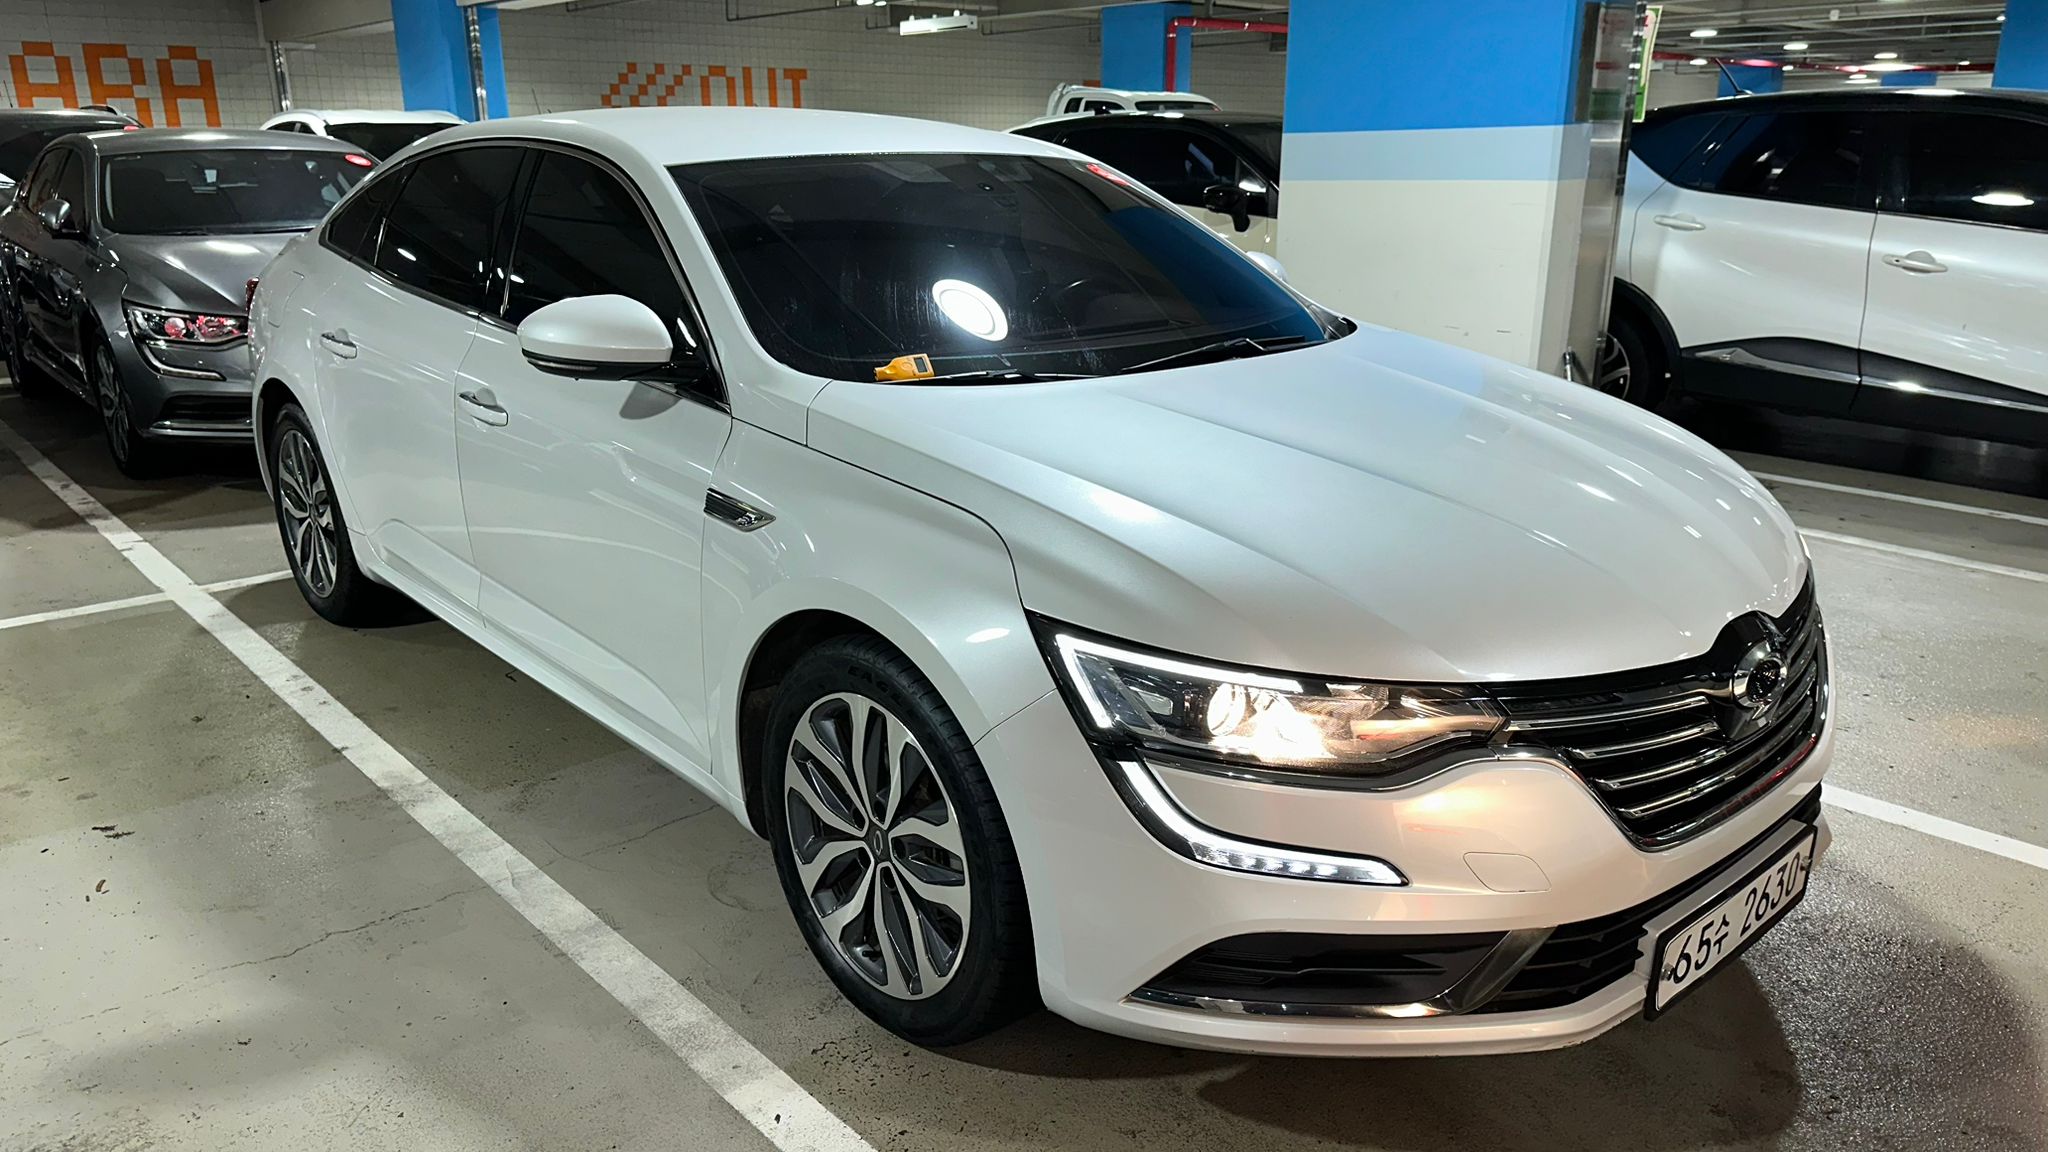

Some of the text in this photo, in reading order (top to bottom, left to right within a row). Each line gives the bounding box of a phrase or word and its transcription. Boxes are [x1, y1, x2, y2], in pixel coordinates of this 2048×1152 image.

[9, 41, 222, 128] ARA
[701, 65, 807, 108] OUT
[1673, 851, 1801, 984] 65수 2630
